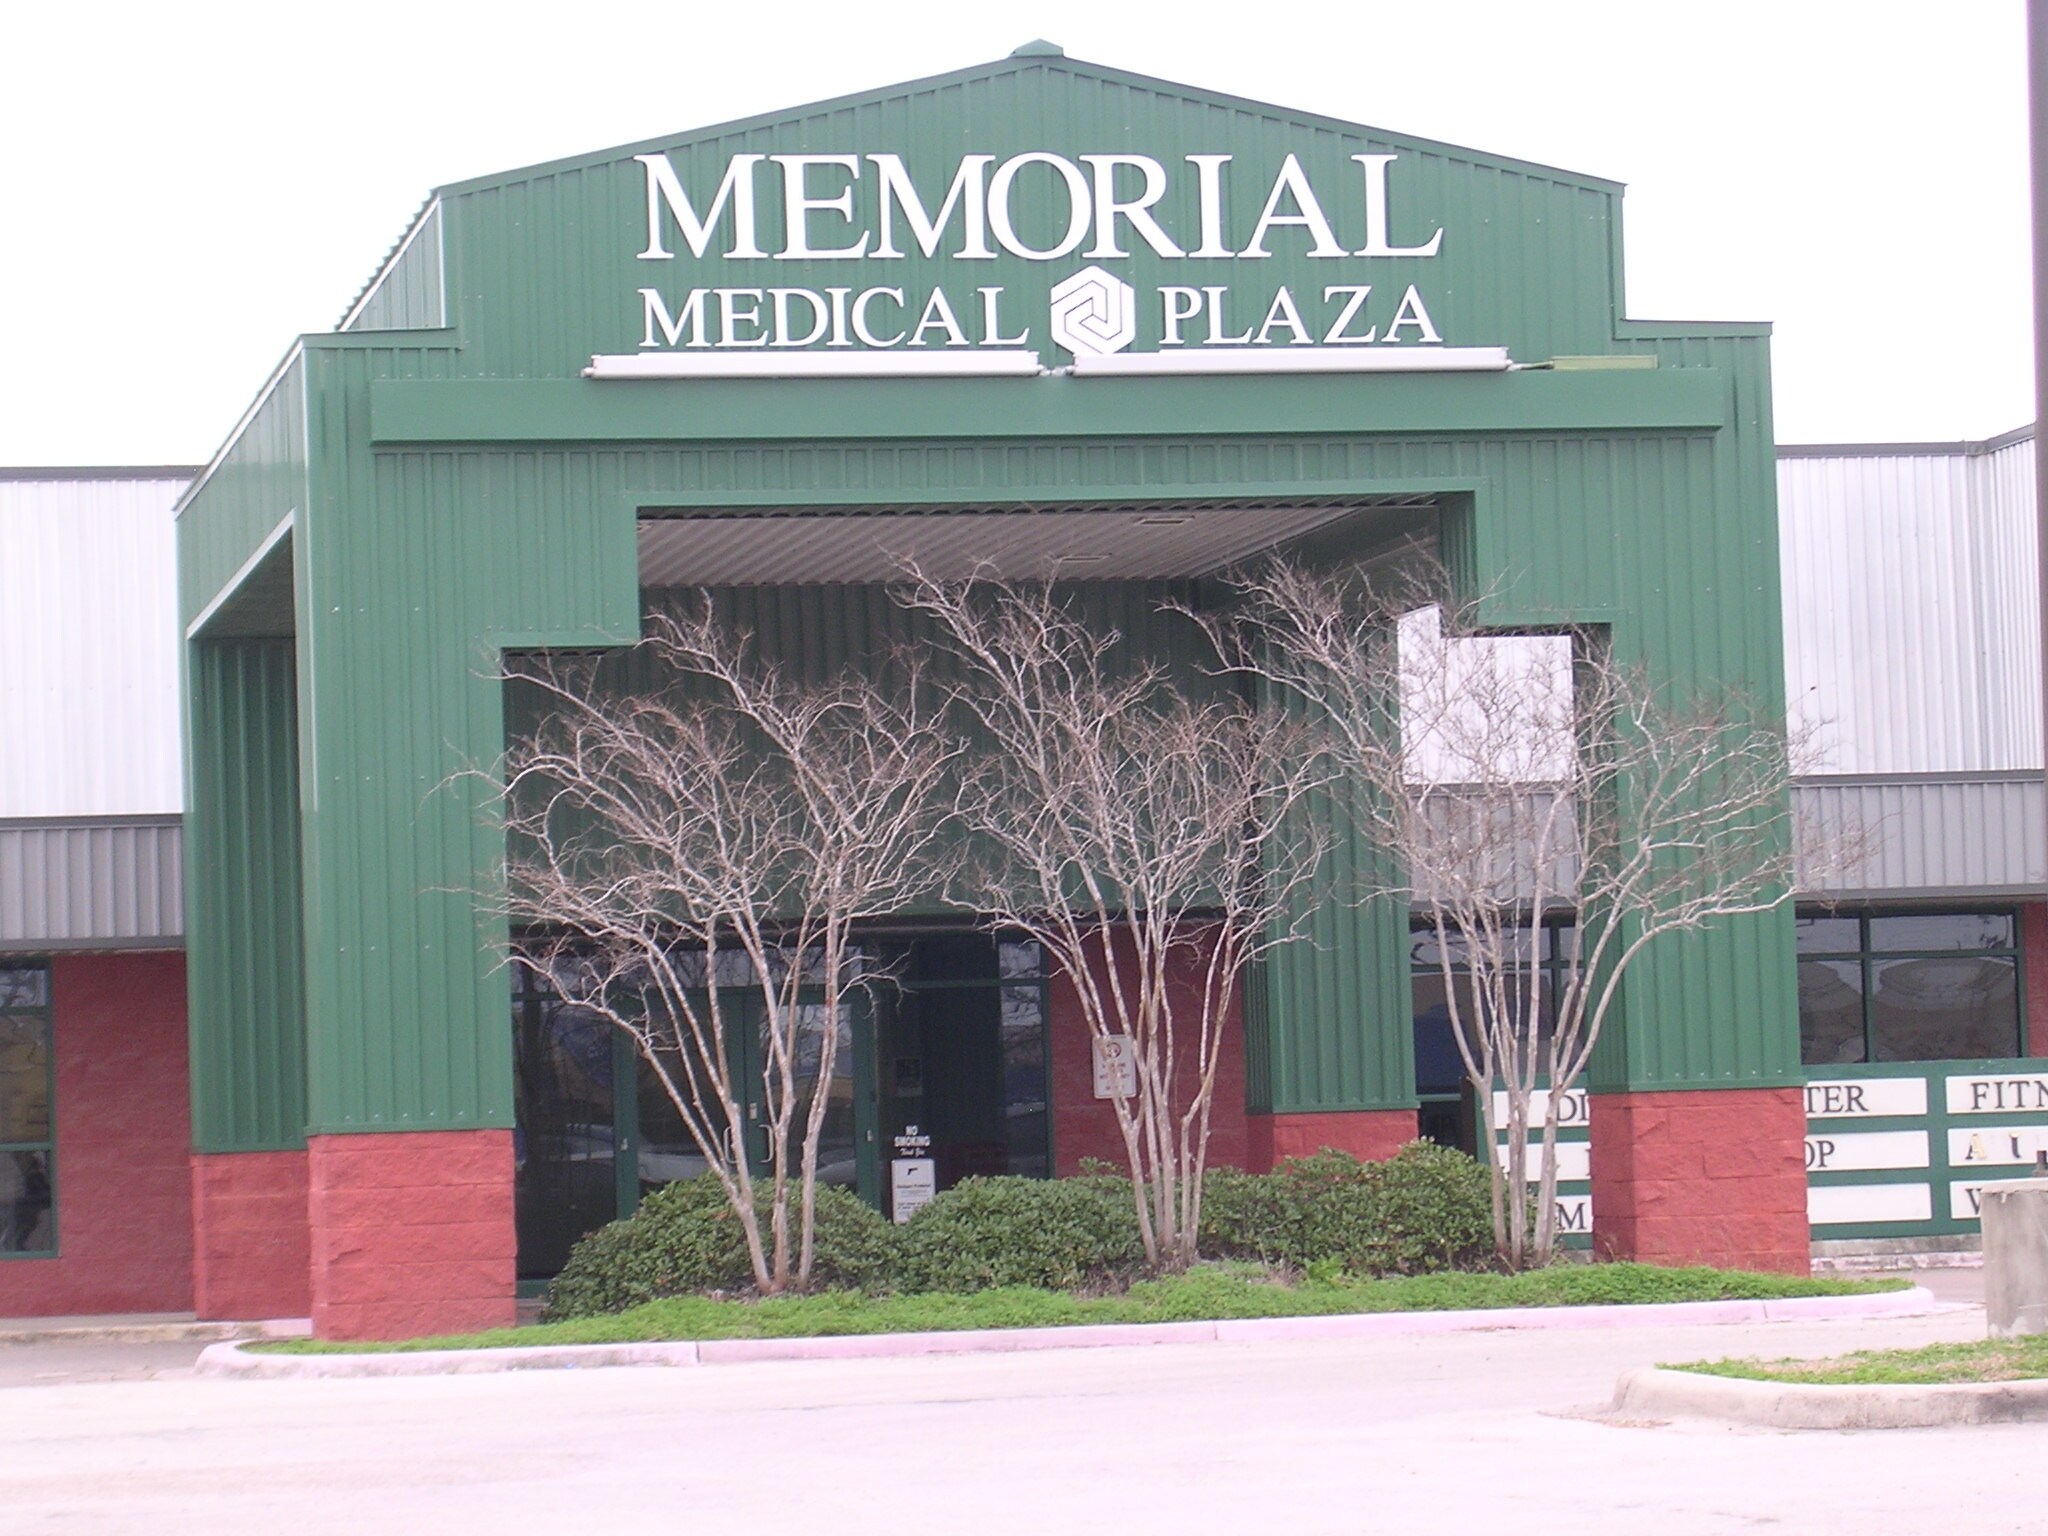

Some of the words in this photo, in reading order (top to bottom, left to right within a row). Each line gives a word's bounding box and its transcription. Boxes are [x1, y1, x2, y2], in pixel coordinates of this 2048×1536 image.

[633, 151, 1444, 260] MEMORIAL
[637, 286, 1030, 347] MEDICAL
[1156, 284, 1443, 344] PLAZA
[1805, 1085, 1869, 1114] TER
[905, 1124, 919, 1136] NO
